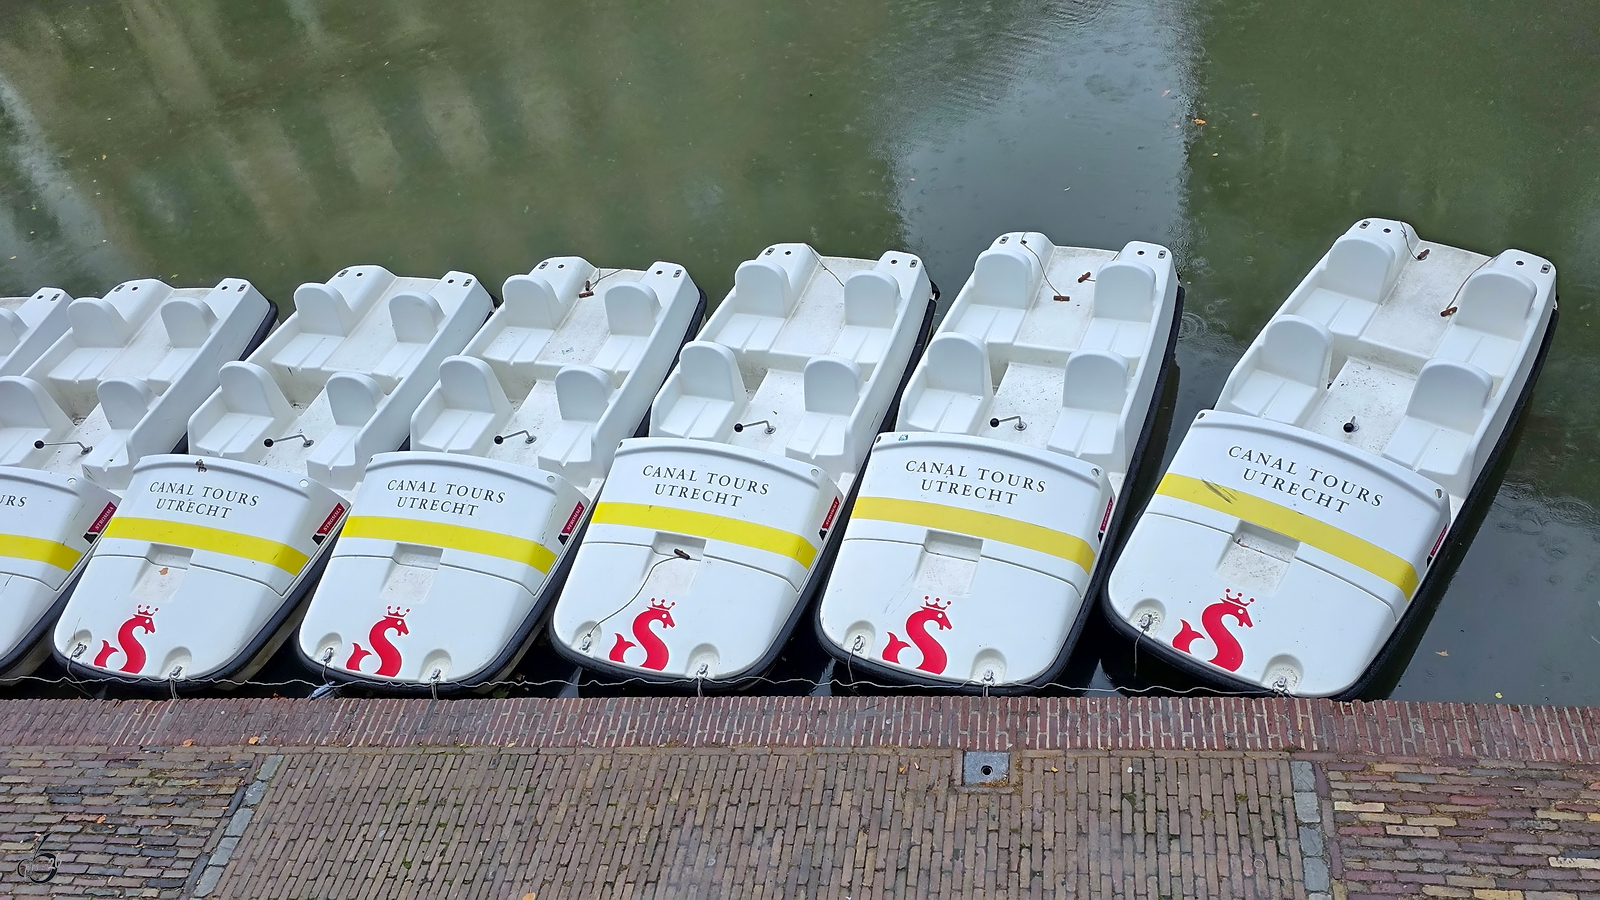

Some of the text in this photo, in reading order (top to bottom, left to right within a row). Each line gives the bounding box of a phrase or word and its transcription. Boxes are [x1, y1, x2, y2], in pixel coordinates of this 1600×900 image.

[642, 464, 770, 495] CANAL TOURS
[905, 460, 1047, 494] CANAL TOURS
[1228, 445, 1385, 508] CANAL TOURS
[149, 481, 260, 507] CANAL TOURS
[387, 479, 506, 504] CANAL TOURS
[654, 481, 743, 508] UTRECHT
[921, 478, 1019, 505] UTRECHT
[1243, 468, 1350, 514] UTRECHT
[156, 498, 233, 519] UTRECHT
[322, 506, 342, 533] STROMMA
[397, 496, 479, 517] UTRECHT
